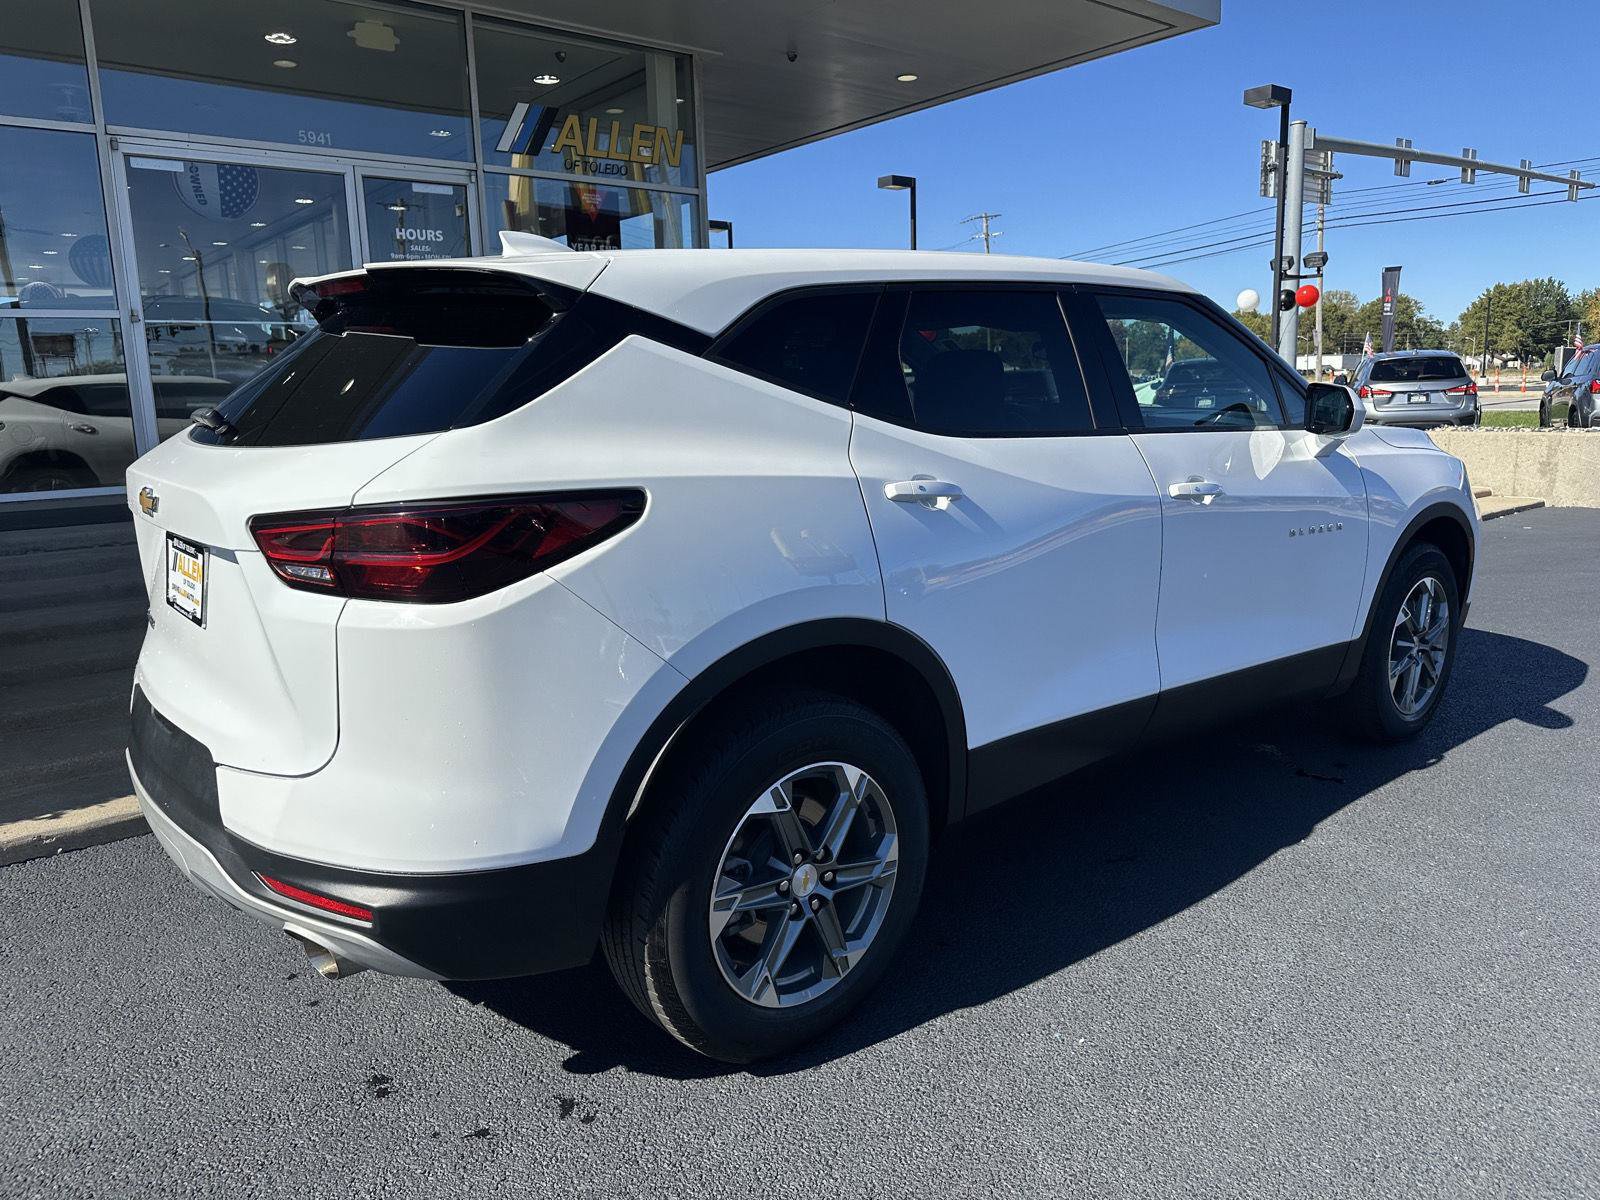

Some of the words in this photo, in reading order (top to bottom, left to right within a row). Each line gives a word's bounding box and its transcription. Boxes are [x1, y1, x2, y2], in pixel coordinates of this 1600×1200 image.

[298, 130, 332, 145] 5941
[551, 114, 684, 167] ALLEN
[564, 159, 582, 171] OF
[584, 160, 629, 176] TOLEDO
[395, 227, 444, 242] HOURS
